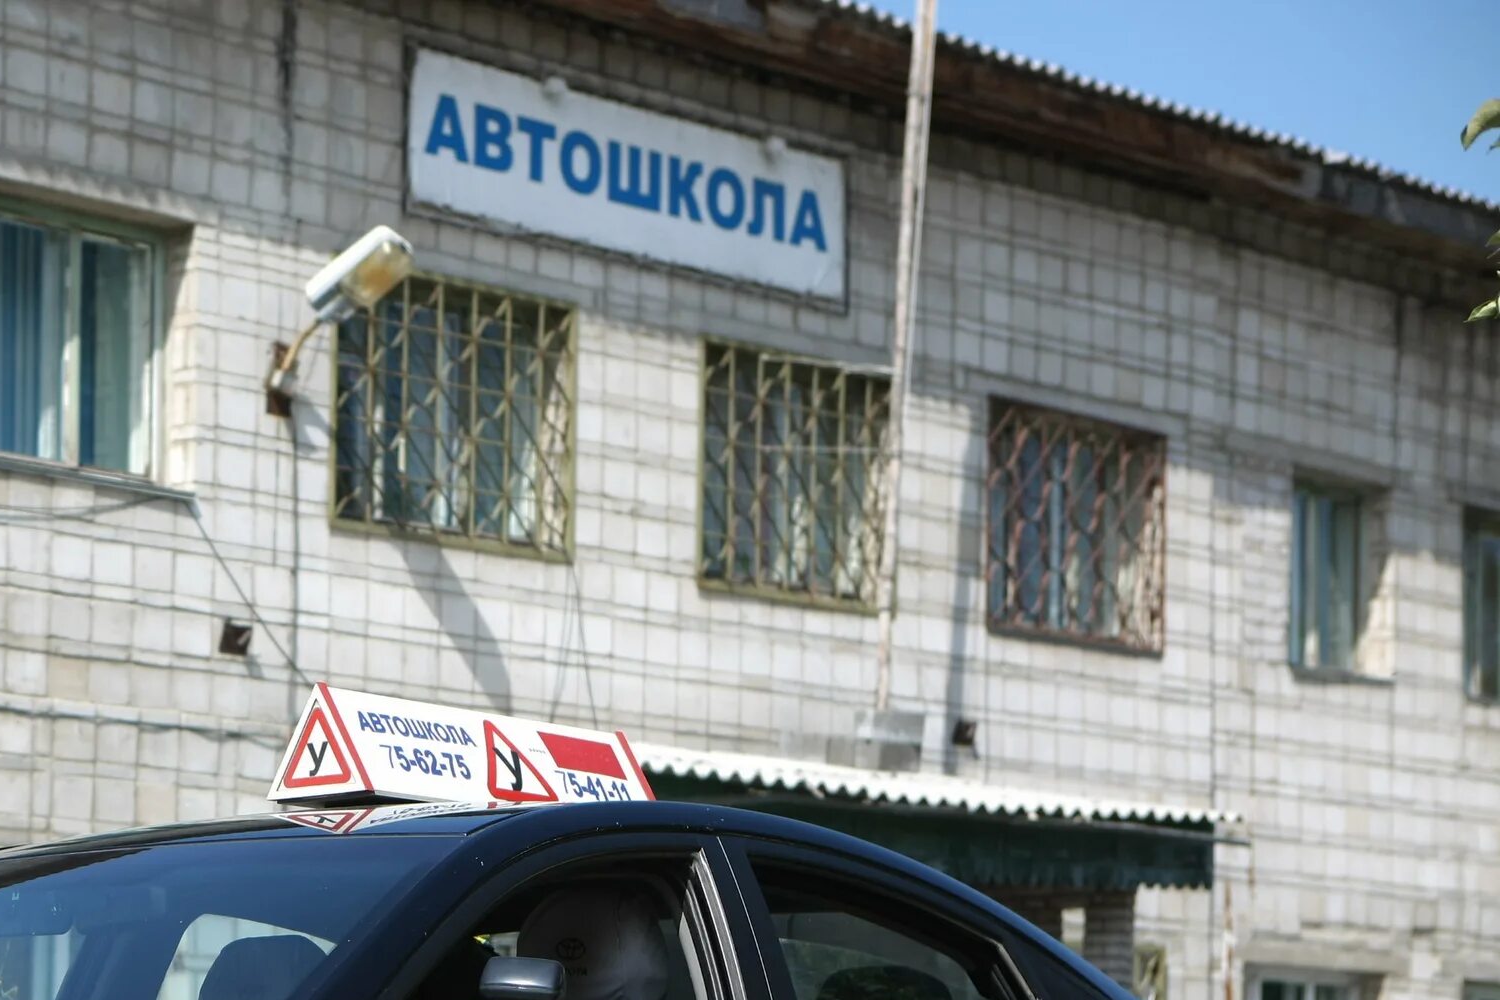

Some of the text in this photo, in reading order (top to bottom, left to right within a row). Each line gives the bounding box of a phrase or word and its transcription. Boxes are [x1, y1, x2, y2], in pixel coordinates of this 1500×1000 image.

[425, 94, 827, 253] АВТОШКОЛА
[357, 711, 477, 747] АВТОШКОЛА
[307, 741, 329, 777] У
[379, 744, 471, 780] 75-62-75
[493, 746, 524, 791] У
[554, 770, 632, 801] 75-41-11
